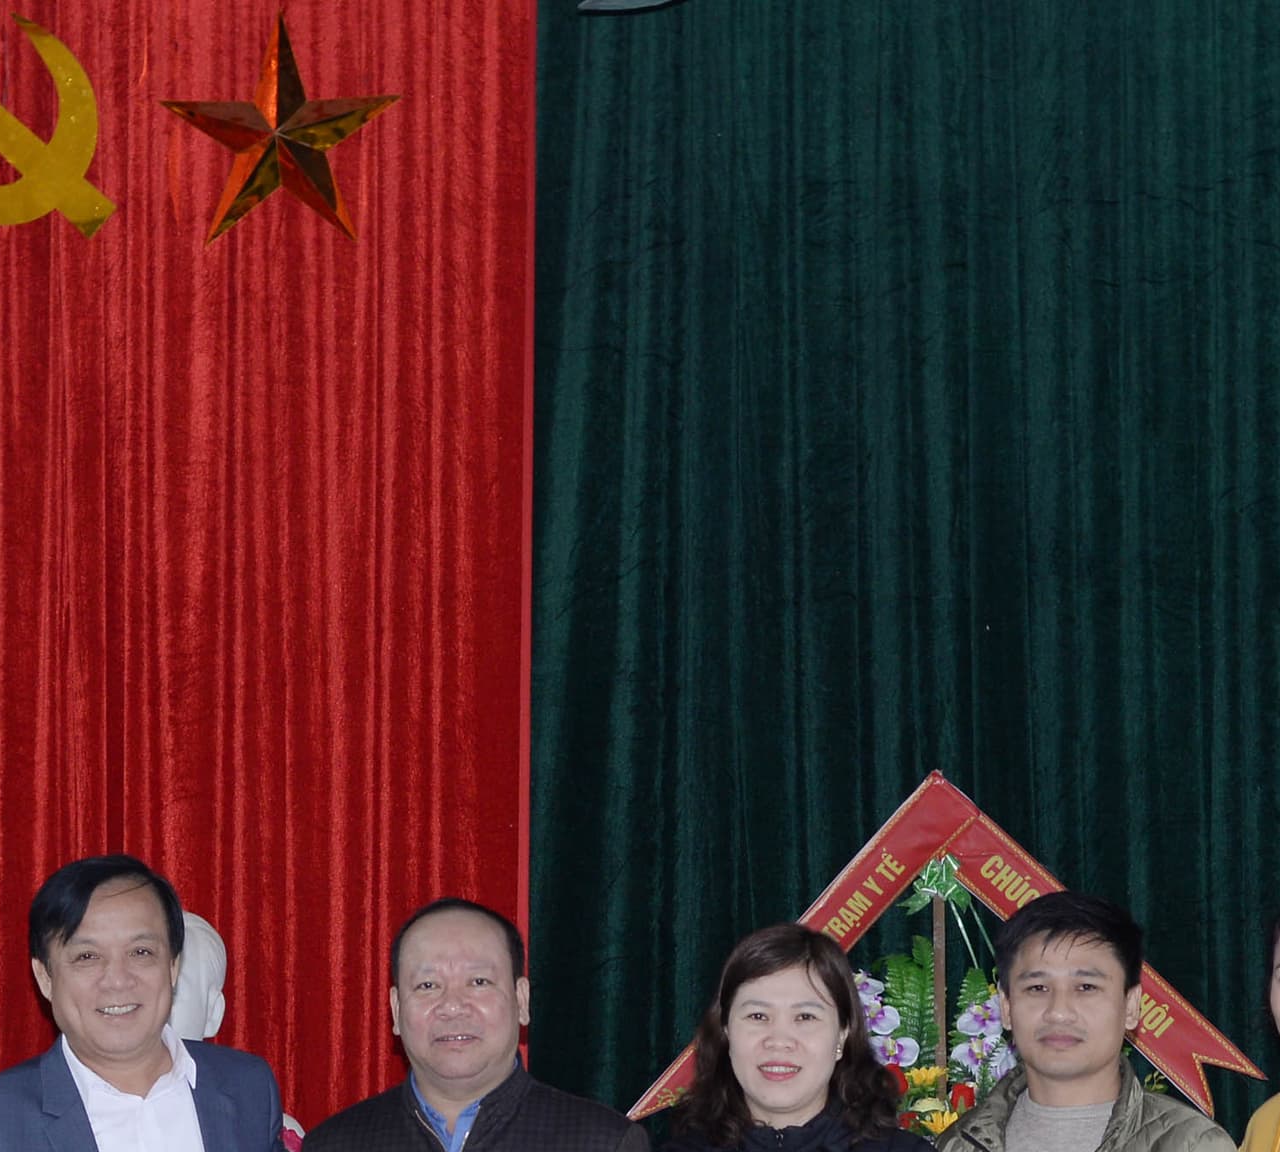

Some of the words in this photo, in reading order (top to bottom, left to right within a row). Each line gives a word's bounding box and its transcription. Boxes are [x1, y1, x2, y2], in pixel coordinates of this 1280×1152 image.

[821, 890, 873, 943] TRẠM
[863, 876, 884, 896] Y
[875, 848, 907, 882] TẾ
